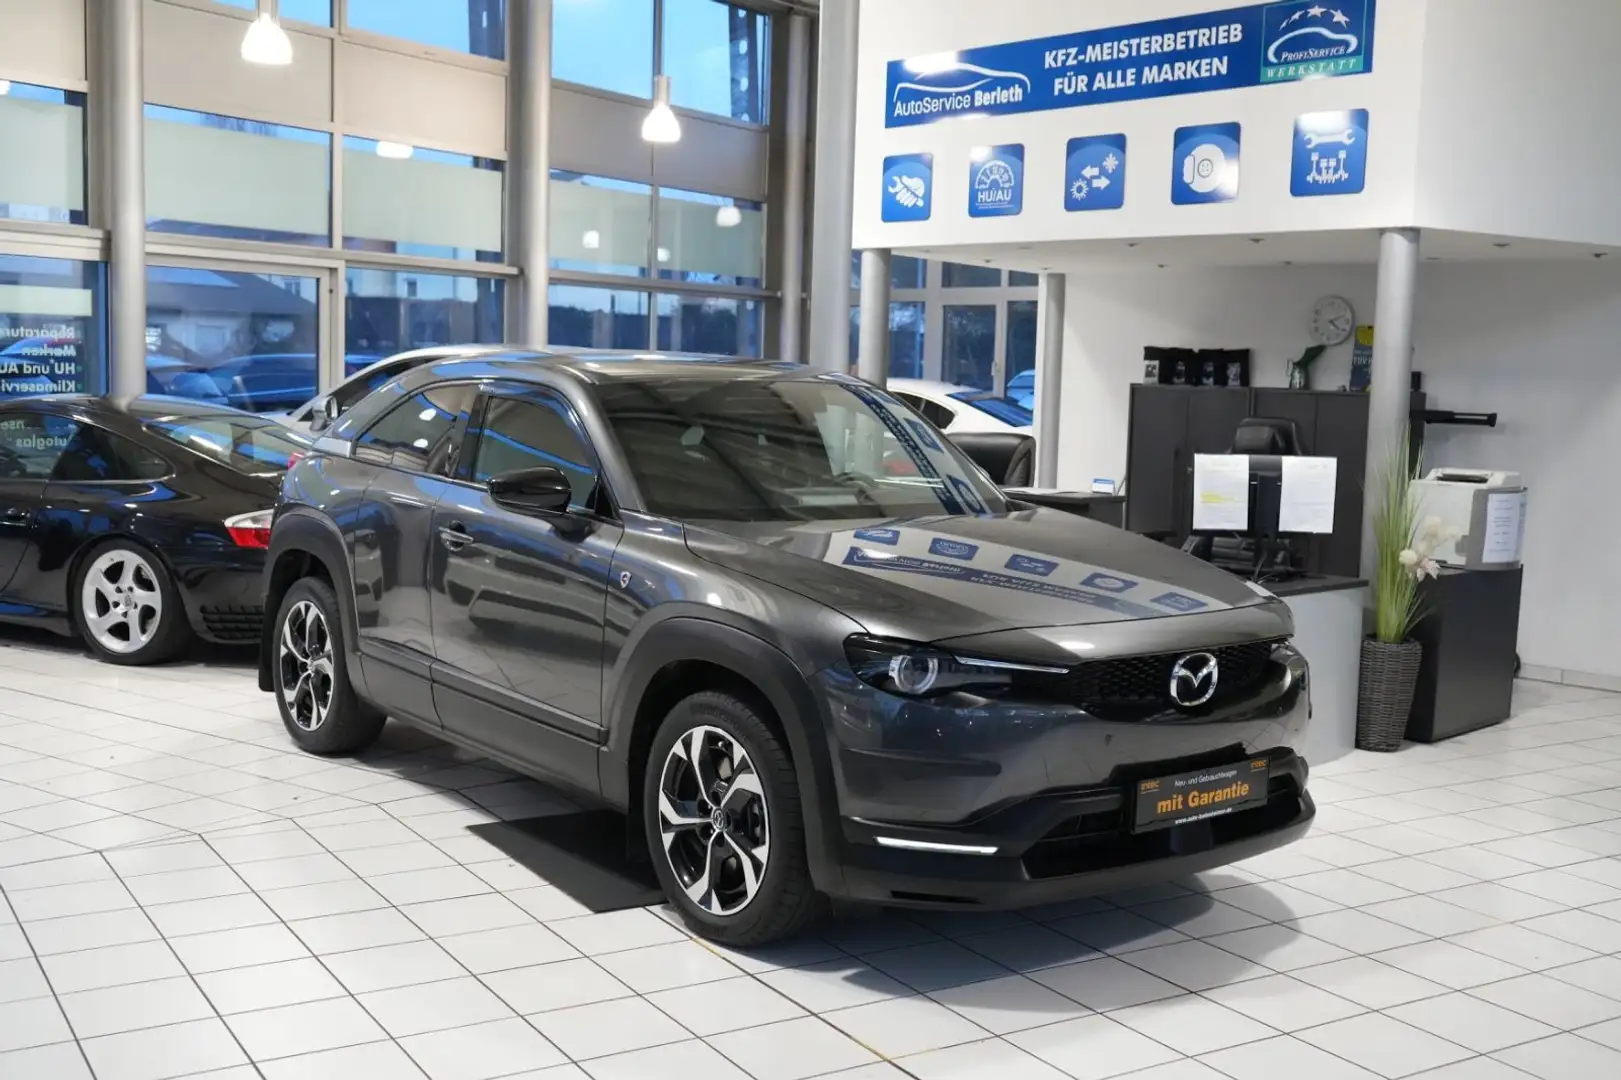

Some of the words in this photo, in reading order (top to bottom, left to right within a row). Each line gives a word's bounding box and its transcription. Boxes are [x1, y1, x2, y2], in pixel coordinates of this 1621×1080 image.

[1044, 23, 1243, 69] KFZ-MEISTERBETRIEB
[1053, 71, 1088, 96] FÜR
[1092, 68, 1136, 91] ALLE
[1141, 56, 1229, 85] MARKEN
[1267, 58, 1357, 78] WERKSTATT
[894, 92, 971, 118] AutoService
[974, 83, 1024, 107] Berleth
[977, 188, 1013, 203] HU/AU
[1157, 792, 1184, 814] mit
[1187, 780, 1250, 808] Garantie
